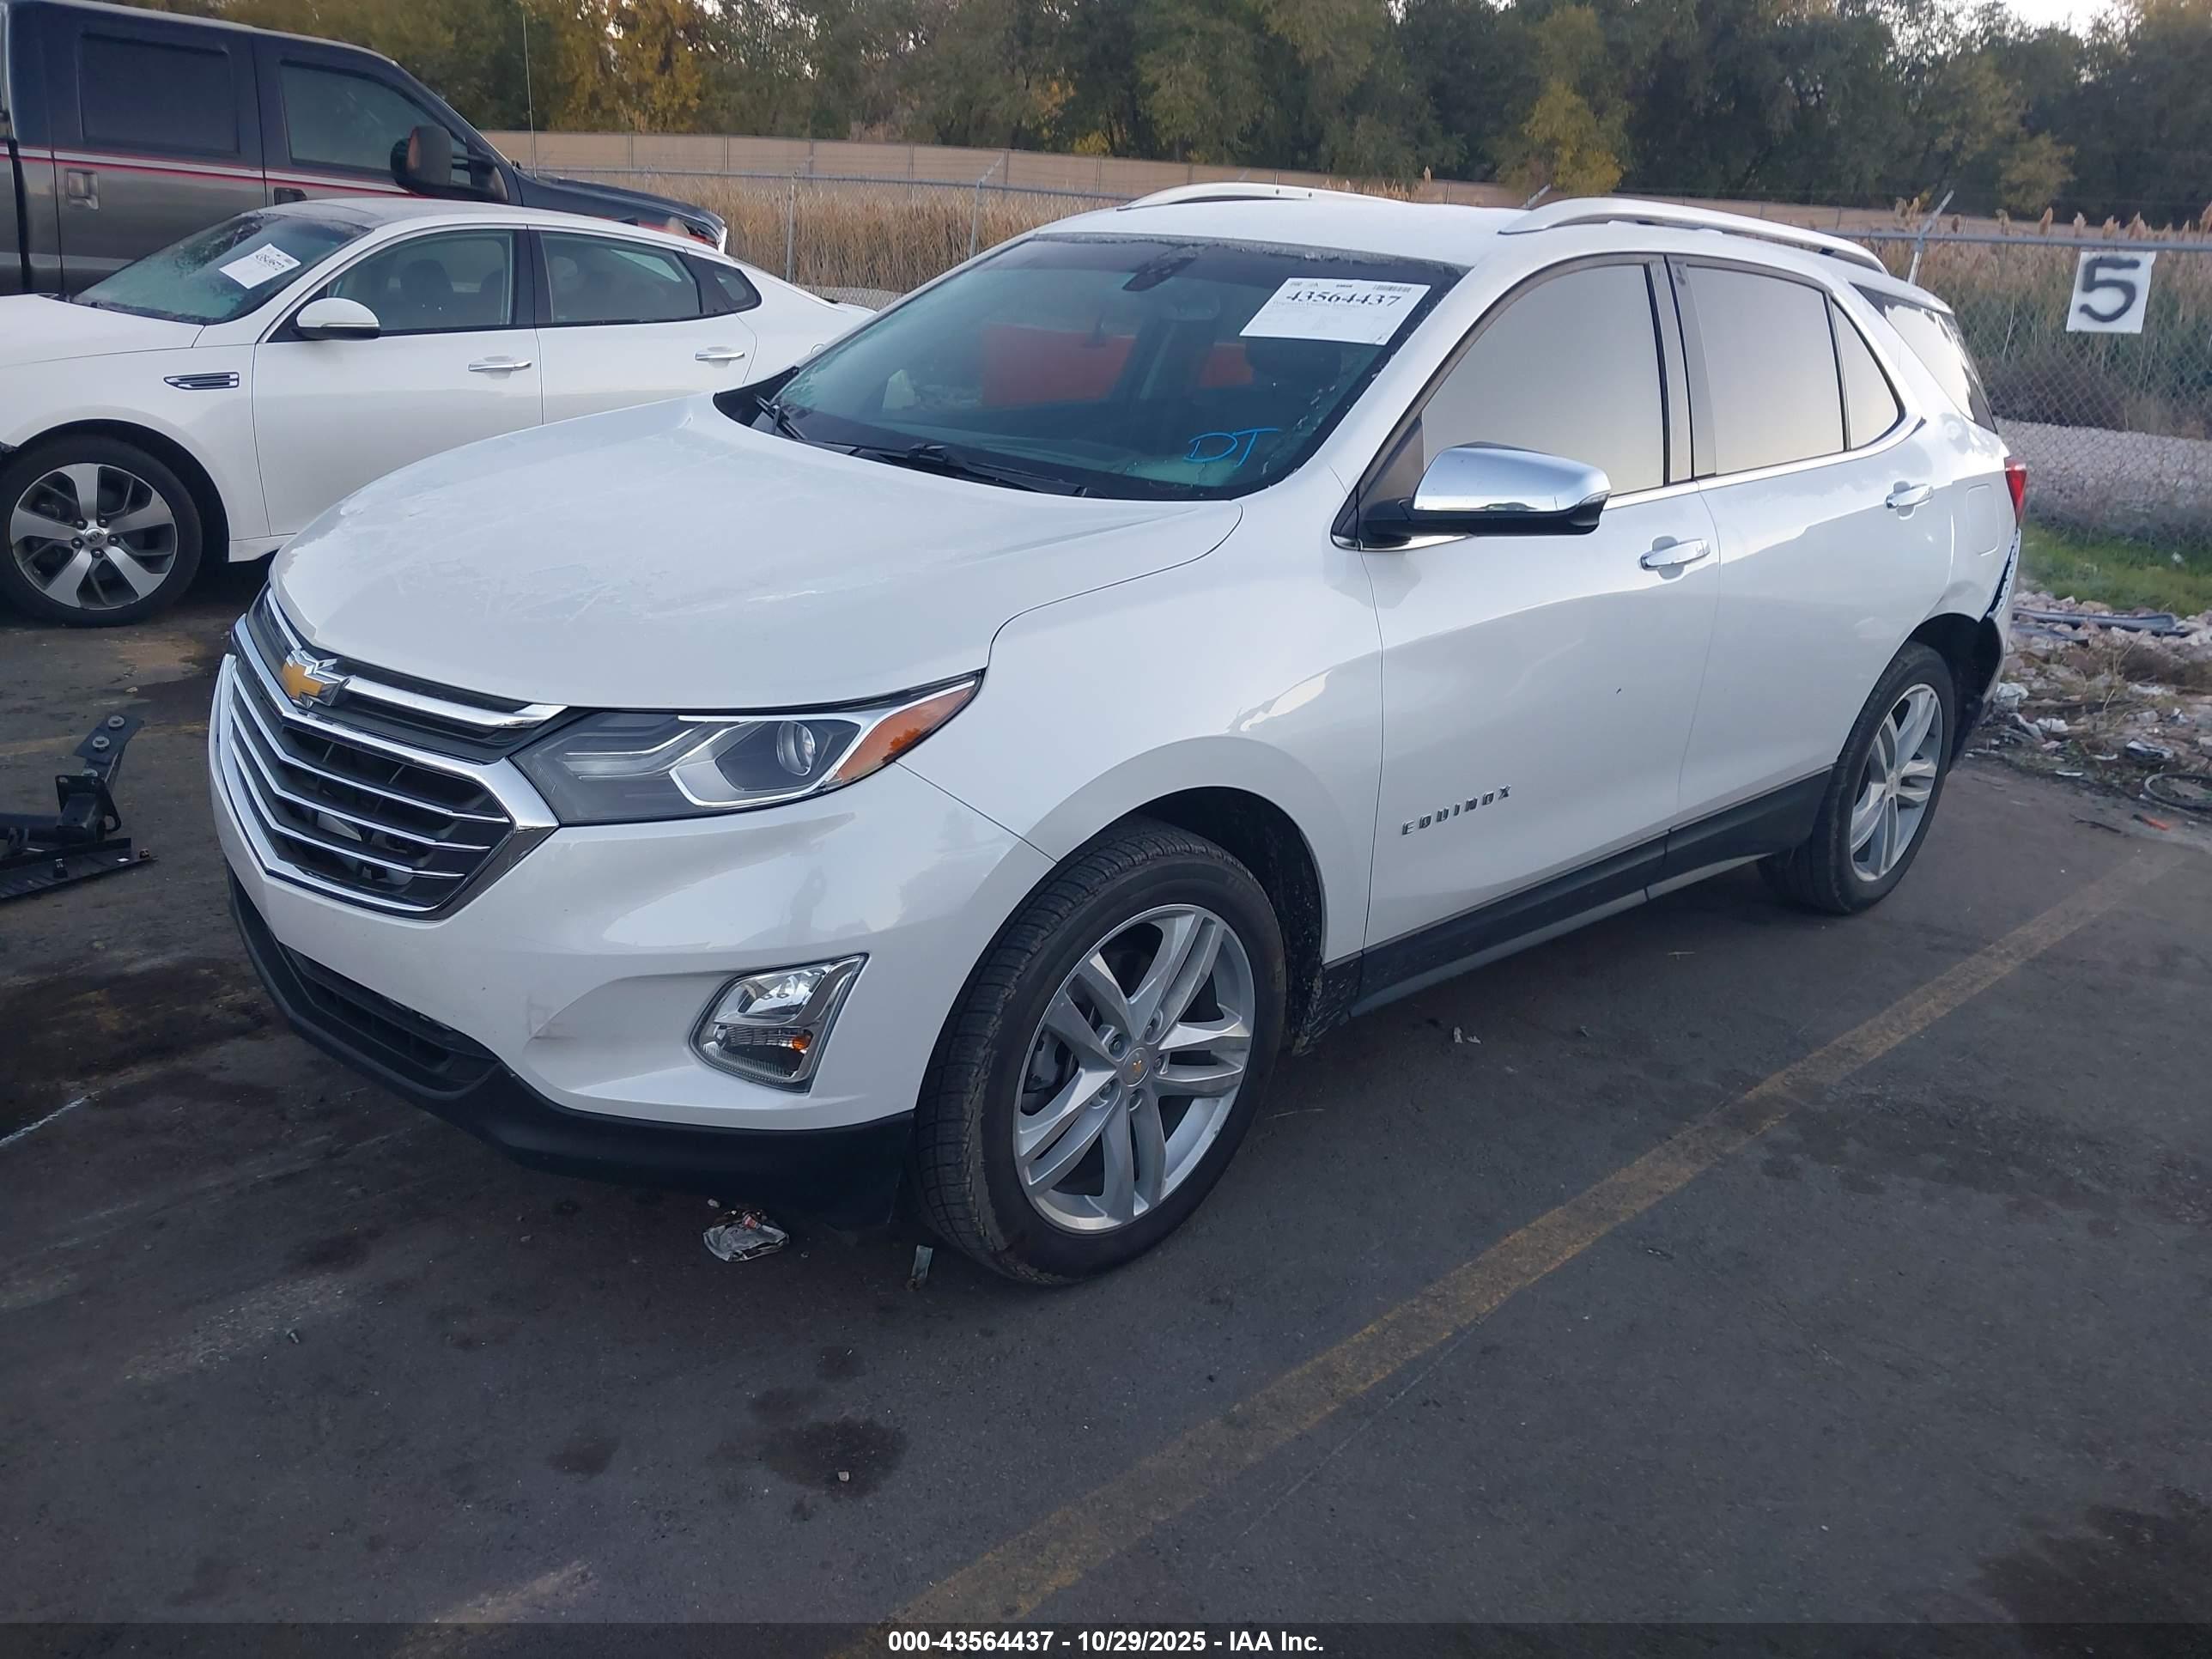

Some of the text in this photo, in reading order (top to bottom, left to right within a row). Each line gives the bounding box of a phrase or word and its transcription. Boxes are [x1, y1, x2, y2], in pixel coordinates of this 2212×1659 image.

[1286, 290, 1402, 307] 43564437
[2079, 256, 2141, 323] 5
[1401, 784, 1511, 836] EQUINOX
